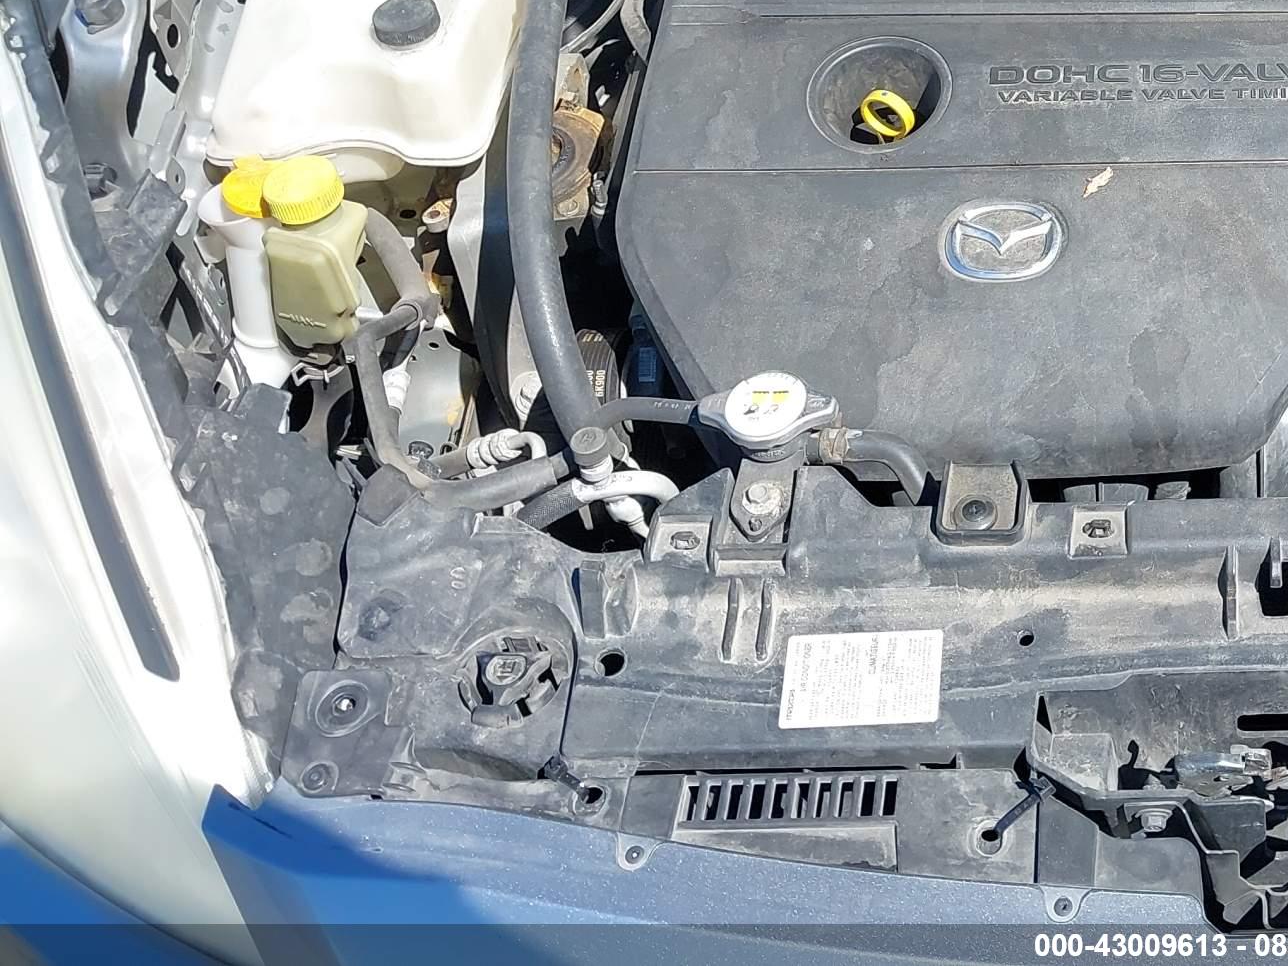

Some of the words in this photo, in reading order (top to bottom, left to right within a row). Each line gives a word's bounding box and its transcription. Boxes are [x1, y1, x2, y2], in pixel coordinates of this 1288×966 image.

[988, 64, 1130, 85] DOHC
[997, 89, 1134, 103] VARIABLE
[1141, 88, 1226, 101] VALVE
[594, 369, 606, 397] 6K900
